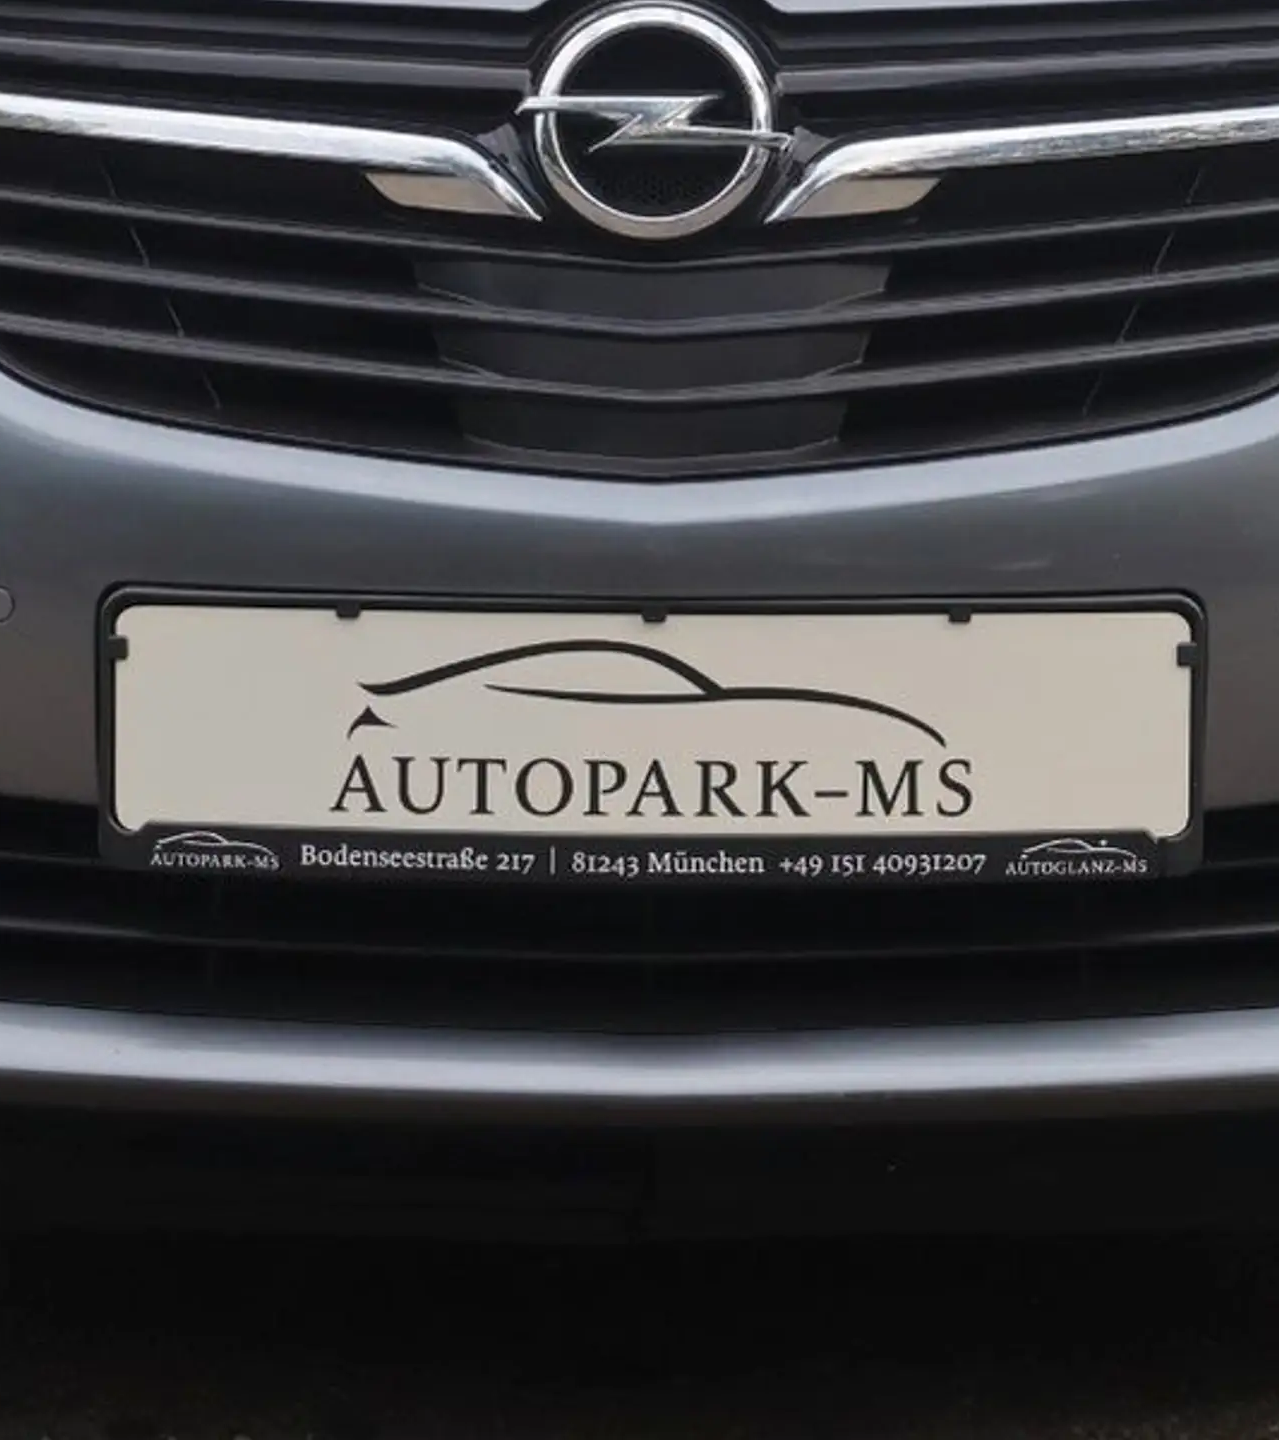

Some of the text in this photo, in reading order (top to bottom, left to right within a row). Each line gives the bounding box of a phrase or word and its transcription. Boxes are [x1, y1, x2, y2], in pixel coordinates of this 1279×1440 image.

[329, 754, 973, 818] AUTOPARK-MS
[150, 851, 280, 870] AUTOPARK-MS
[301, 843, 489, 871] Bodenseestraße
[496, 853, 535, 874] 217
[571, 851, 640, 877] 81243
[647, 850, 765, 874] München
[779, 854, 823, 876] +49
[831, 854, 865, 876] 151
[872, 853, 987, 876] 40931207
[1005, 858, 1149, 876] AUTOGLANZ-MS
